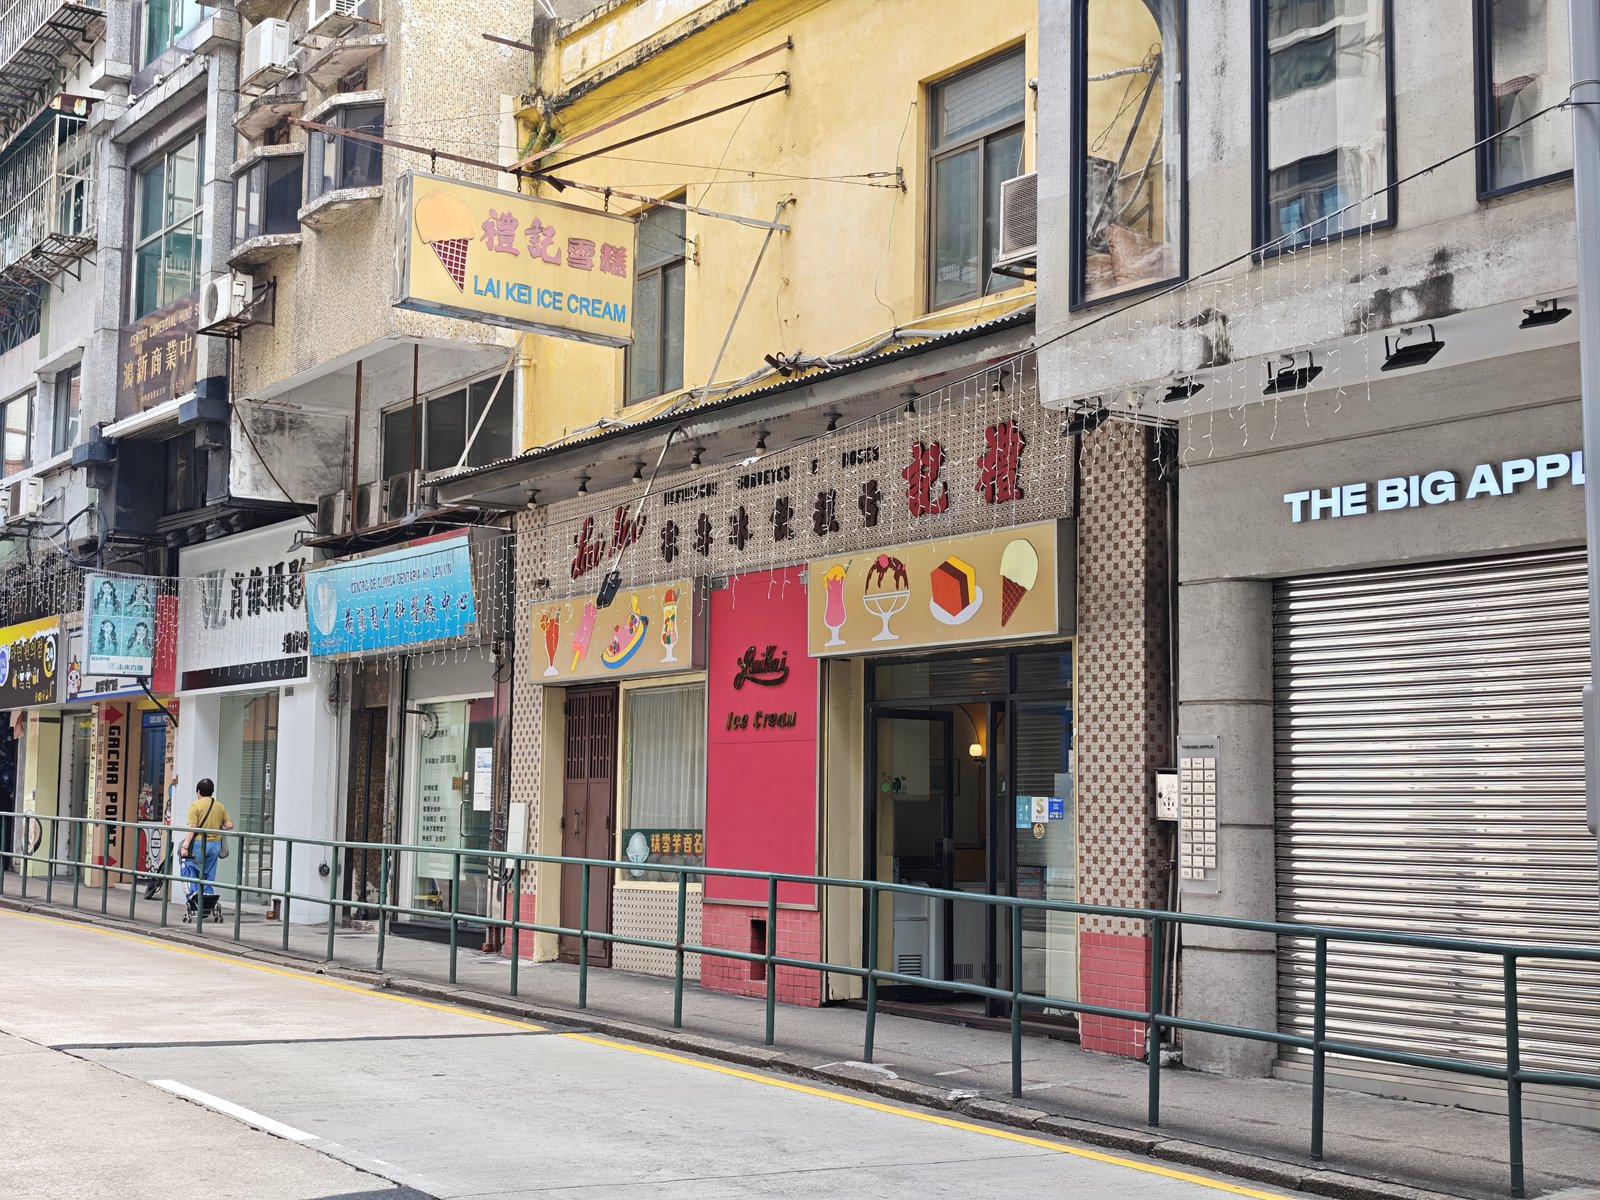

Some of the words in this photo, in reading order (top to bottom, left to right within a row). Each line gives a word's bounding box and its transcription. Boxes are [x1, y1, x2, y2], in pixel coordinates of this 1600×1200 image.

[479, 208, 628, 279] 禮記雪糕
[474, 275, 501, 299] LAI
[505, 282, 532, 305] KEI
[537, 288, 563, 311] ICE
[567, 294, 627, 323] CREAM
[122, 332, 198, 391] 鴻新商業中
[1283, 482, 1369, 524] THE
[1377, 470, 1458, 512] BIG
[1465, 450, 1587, 500] APPL
[351, 580, 369, 594] CENTRO
[370, 578, 377, 590] DE
[726, 711, 748, 731] Ice
[753, 710, 797, 729] Cream
[107, 725, 120, 785] GACHA
[104, 791, 118, 847] PONT
